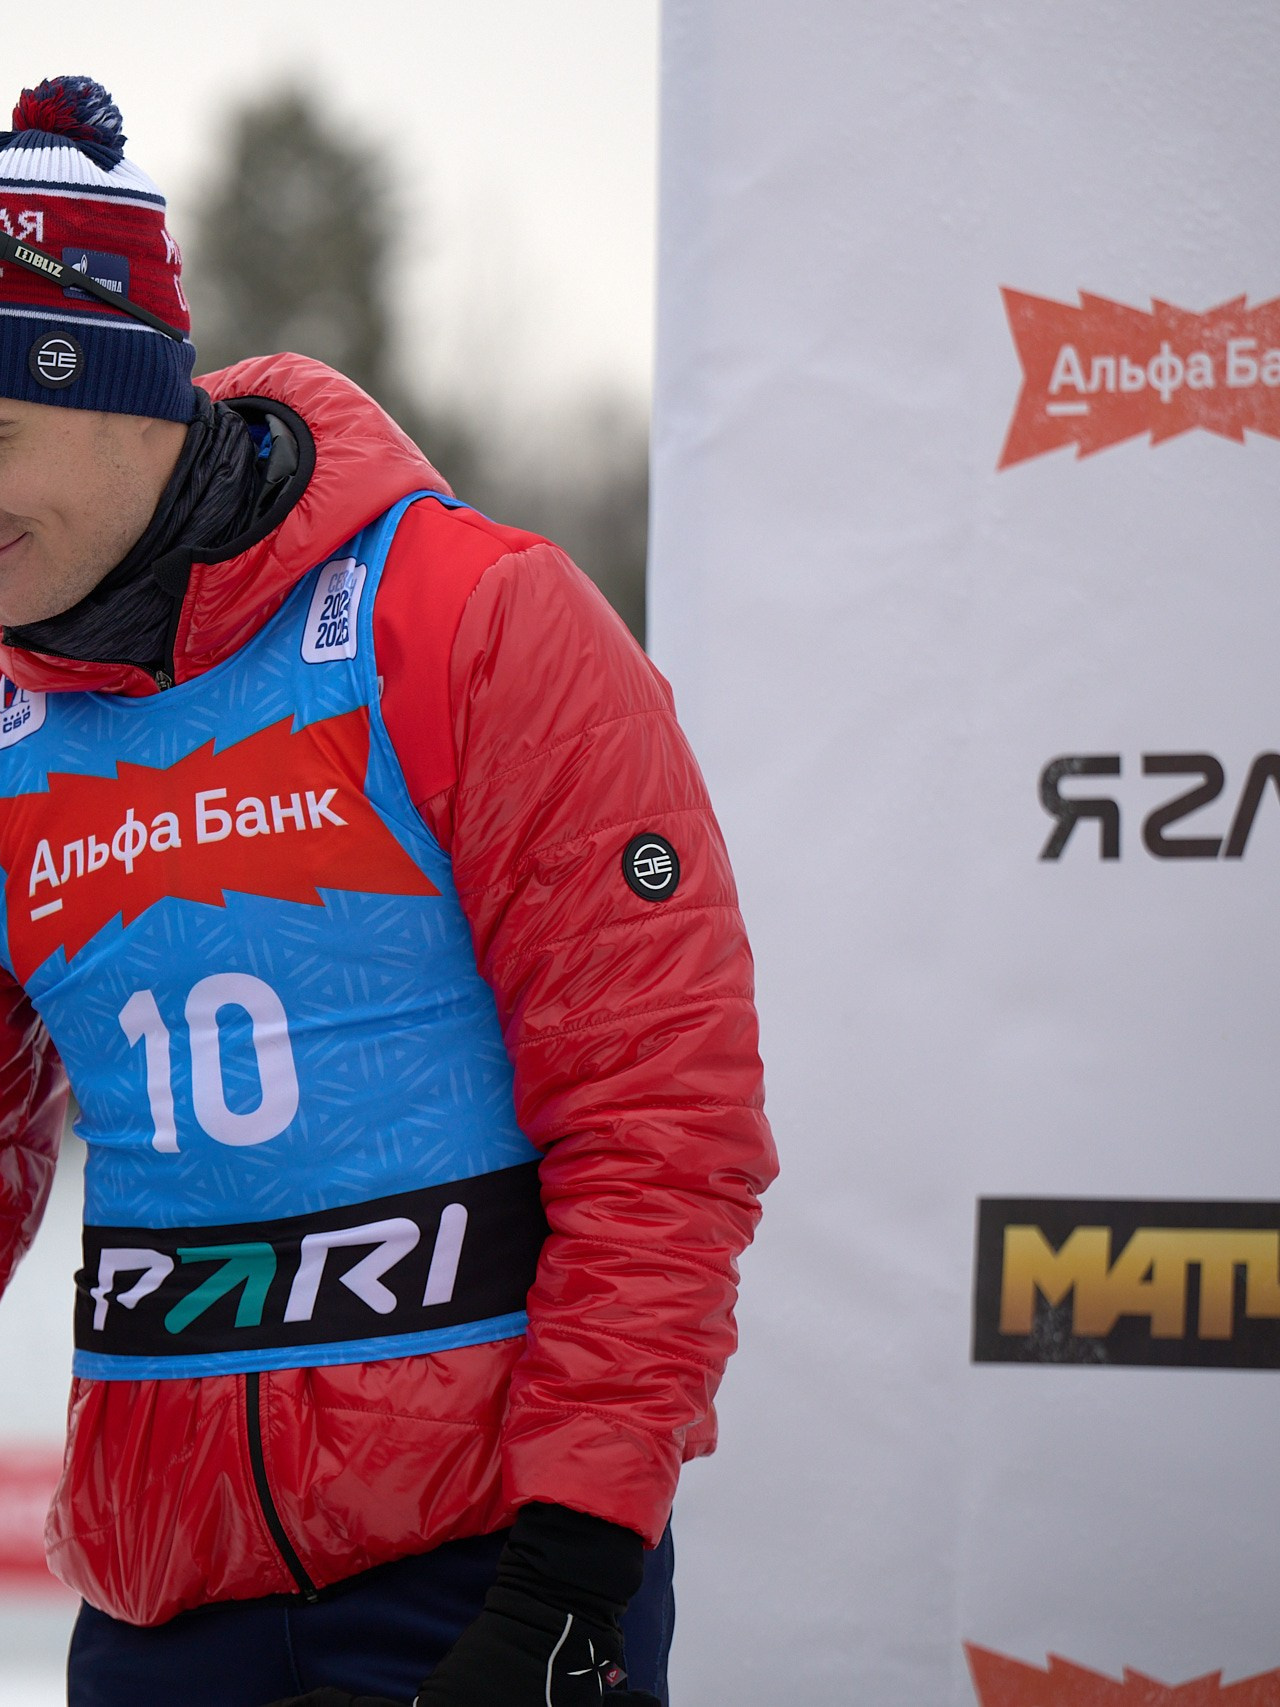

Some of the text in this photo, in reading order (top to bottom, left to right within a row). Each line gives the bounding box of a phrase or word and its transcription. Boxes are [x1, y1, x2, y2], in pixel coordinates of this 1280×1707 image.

[31, 254, 64, 278] BLIZ
[1047, 338, 1280, 405] Альфа Ба
[2, 711, 31, 734] СБР
[28, 787, 349, 900] Альфа Банк
[118, 972, 300, 1154] 10
[90, 1203, 469, 1335] PARI
